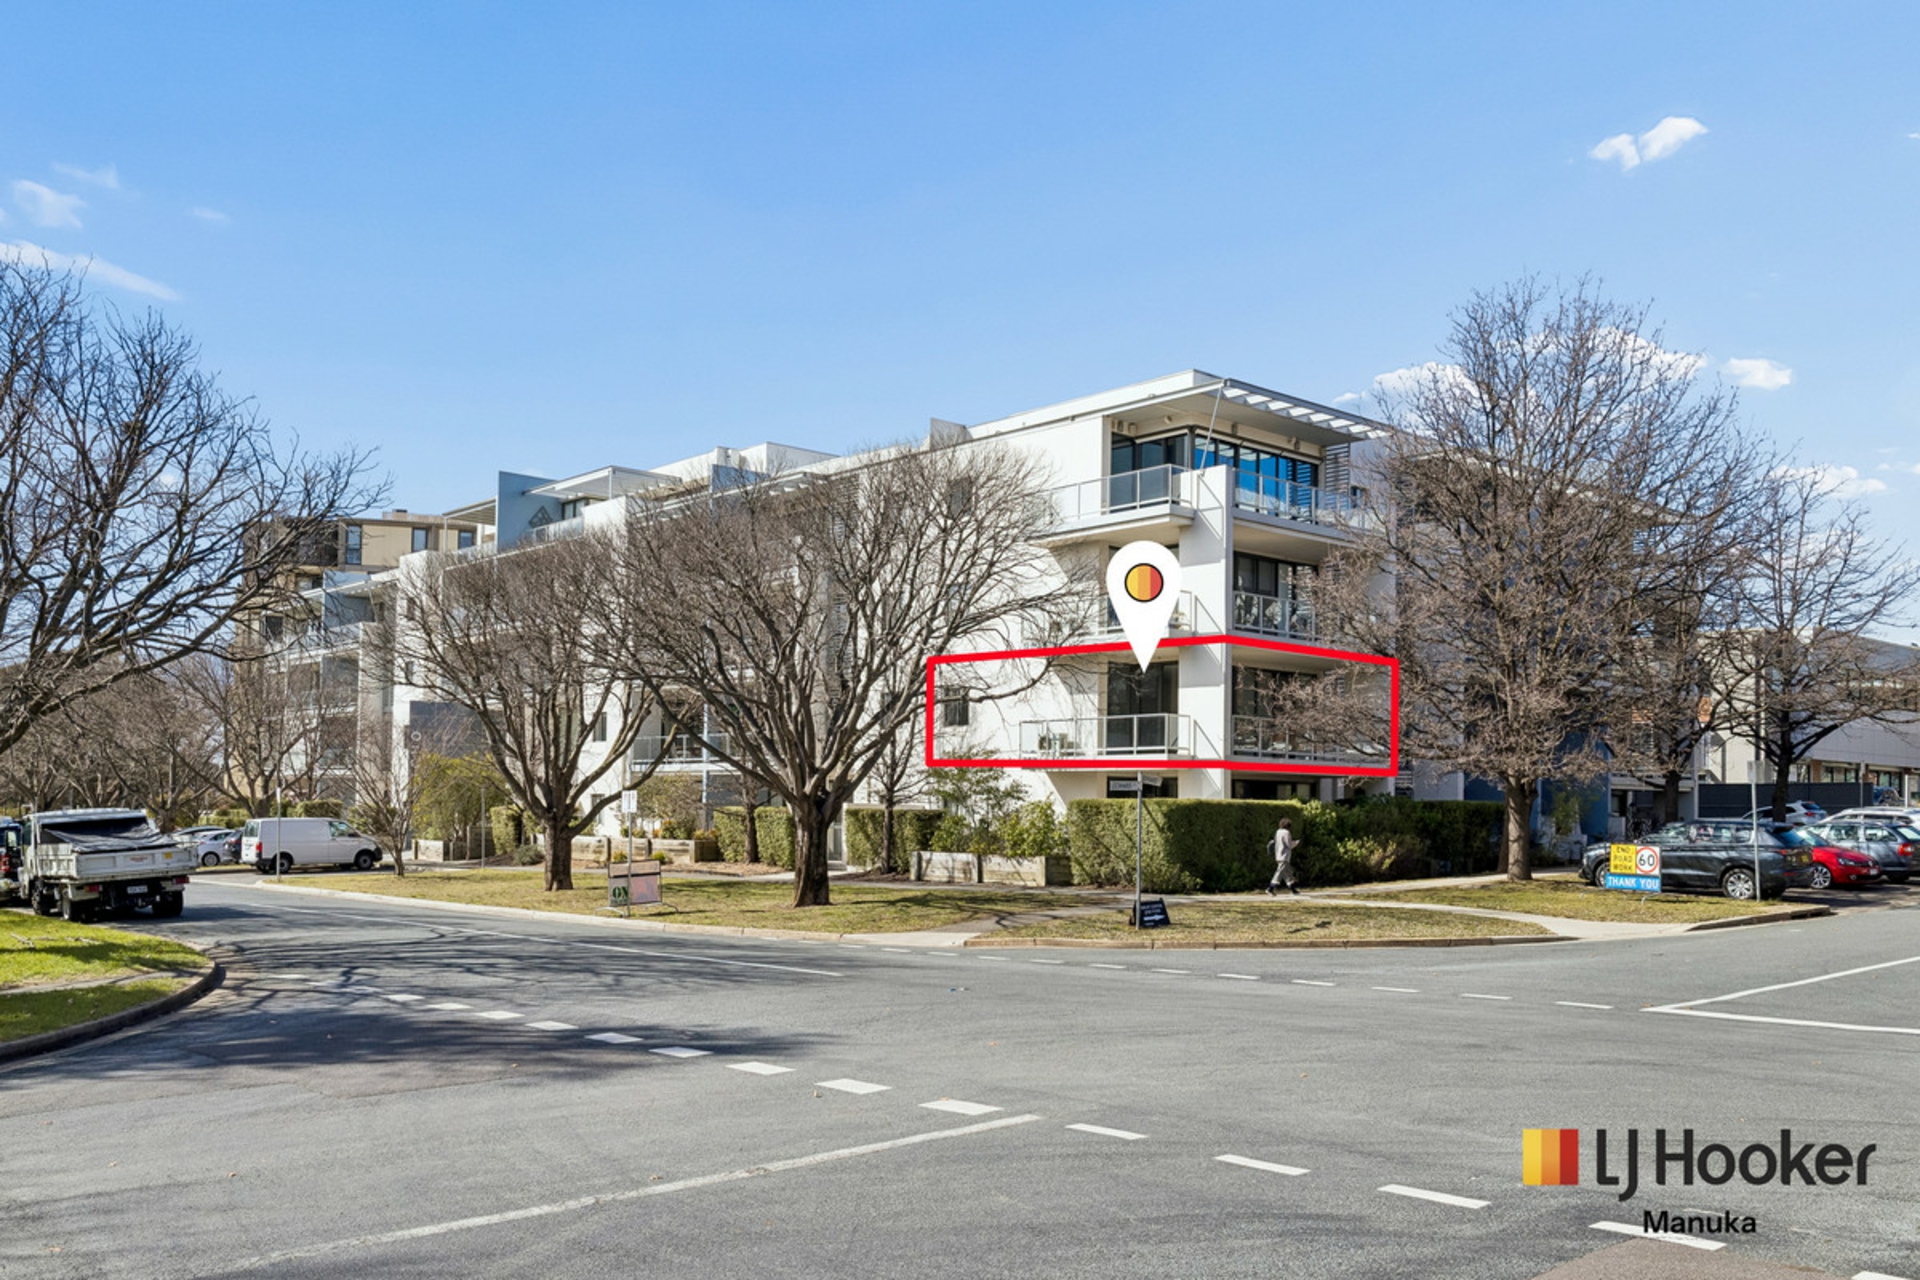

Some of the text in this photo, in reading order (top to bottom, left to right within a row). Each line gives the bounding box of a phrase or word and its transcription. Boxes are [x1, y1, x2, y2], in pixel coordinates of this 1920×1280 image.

[1638, 854, 1655, 866] 60
[1613, 863, 1632, 871] WORK
[1608, 876, 1659, 889] THANK YOU
